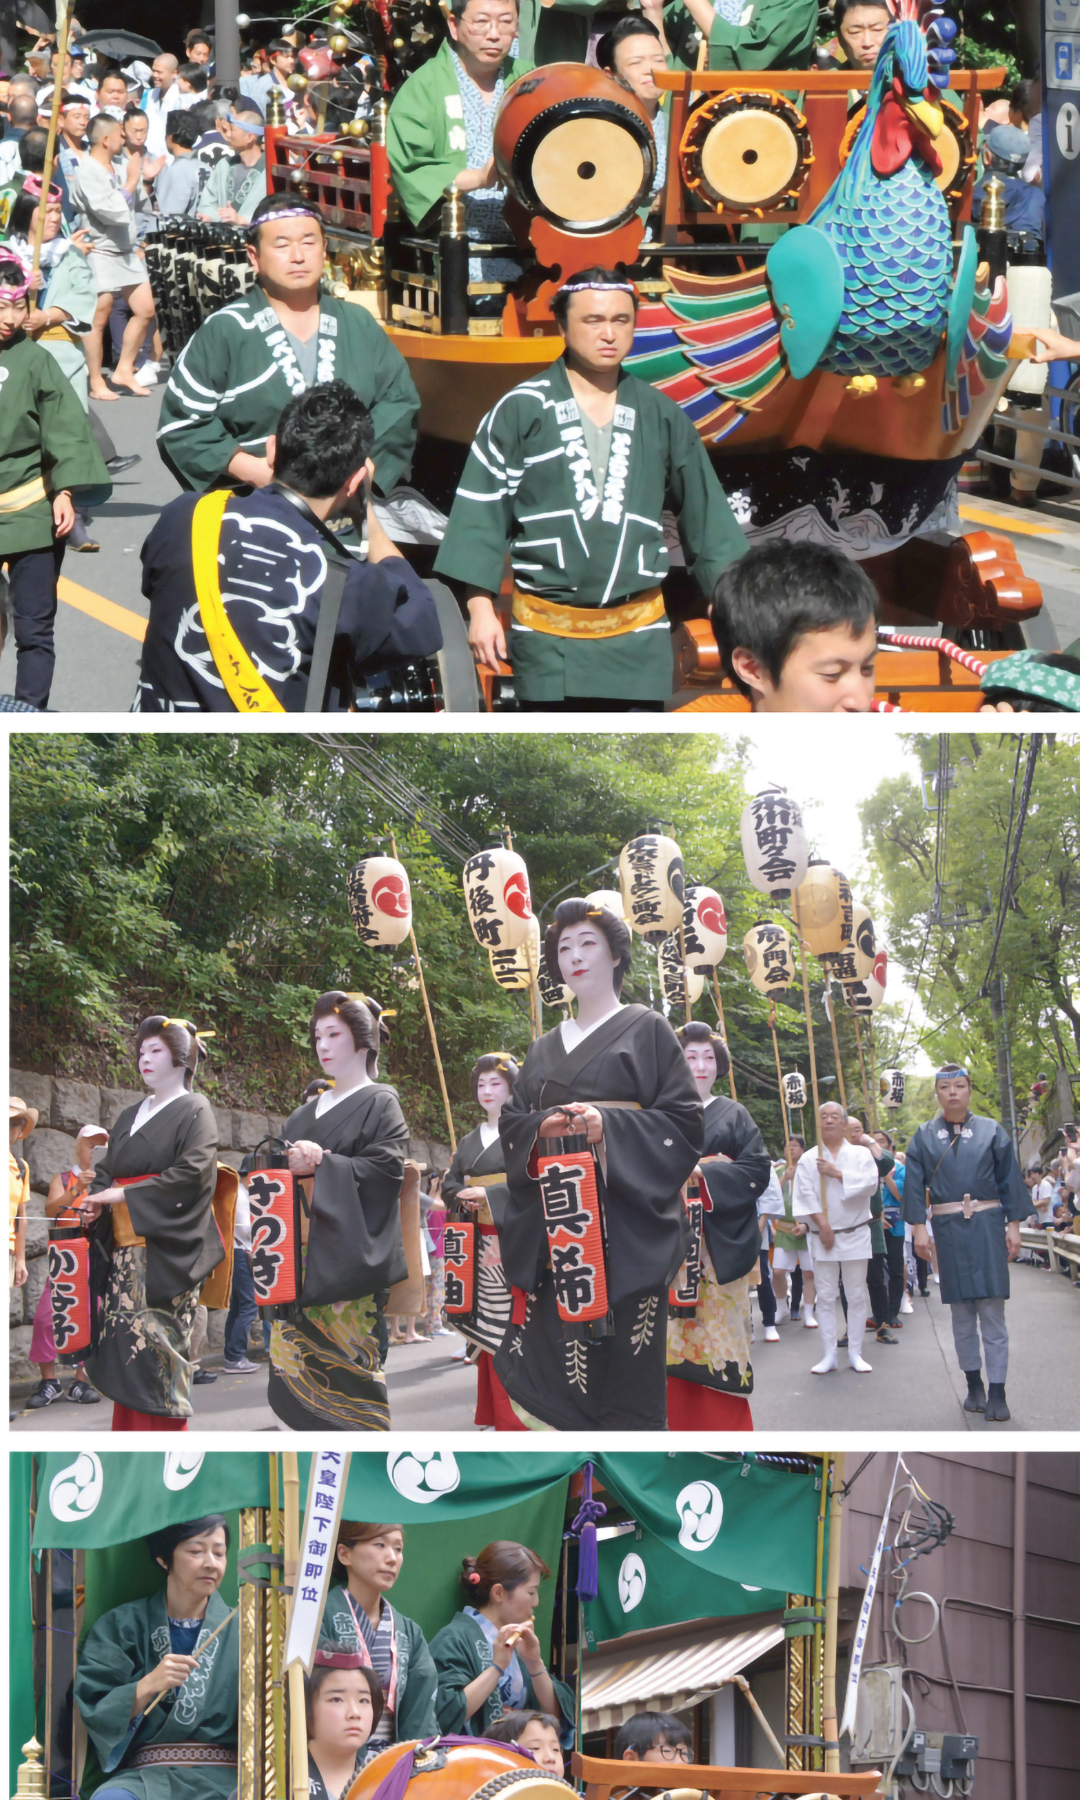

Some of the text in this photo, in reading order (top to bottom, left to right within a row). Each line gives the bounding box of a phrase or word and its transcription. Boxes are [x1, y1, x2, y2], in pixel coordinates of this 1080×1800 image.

[464, 852, 504, 947] 丹後町
[756, 927, 791, 984] 虎ノ門会
[785, 1074, 804, 1105] 赤坂
[891, 1071, 906, 1104] 赤坂
[249, 1175, 284, 1299] さつき
[444, 1226, 469, 1307] 真由
[539, 1163, 596, 1316] 真希
[48, 1244, 77, 1351] かな子
[301, 1451, 341, 1603] 天皇陛下御即位
